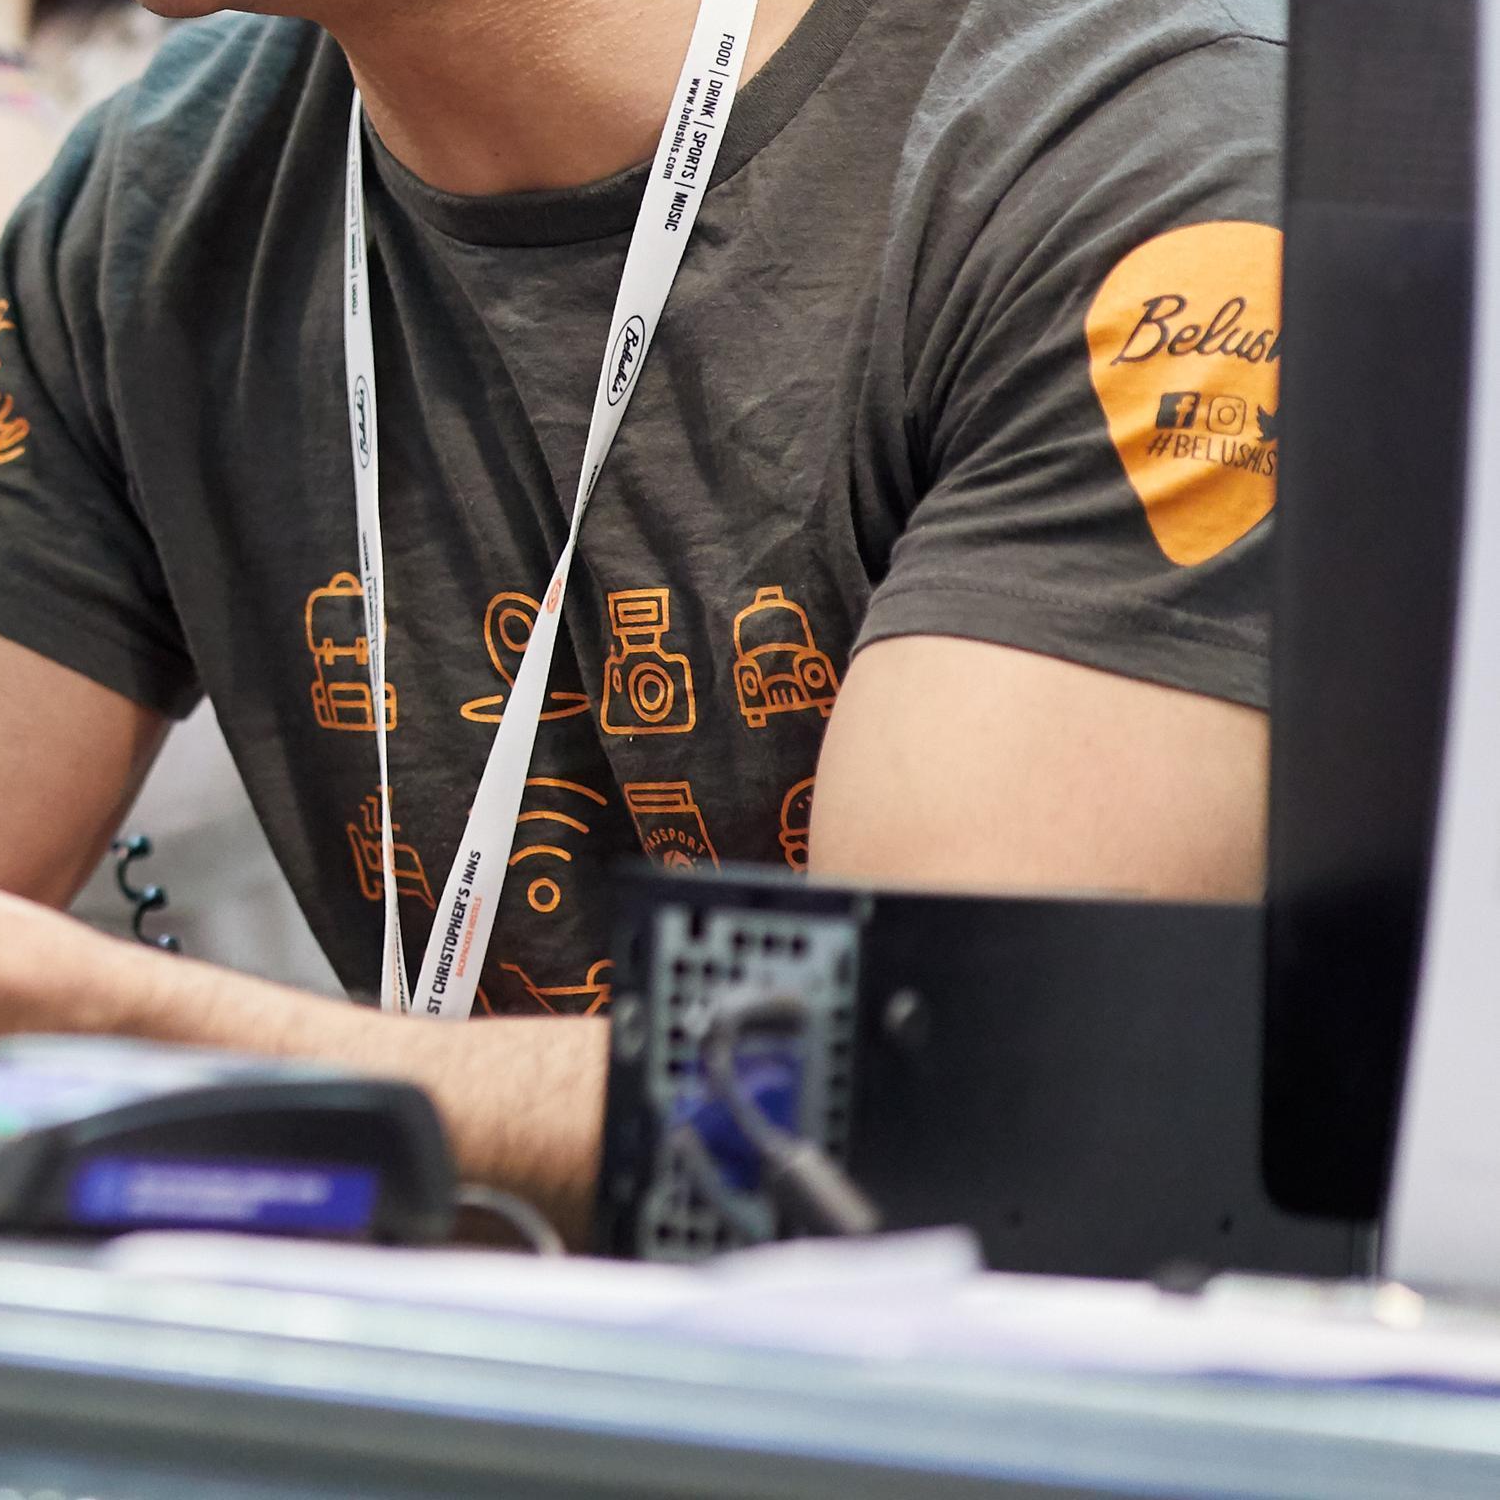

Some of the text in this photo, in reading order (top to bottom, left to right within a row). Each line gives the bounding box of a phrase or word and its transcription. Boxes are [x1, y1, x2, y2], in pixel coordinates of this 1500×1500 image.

[663, 78, 701, 180] www.belushis.com
[665, 33, 735, 232] FOOD DRINK SPORTS MUSIC
[427, 851, 481, 1015] ST CHRISTOPHER'S INNS
